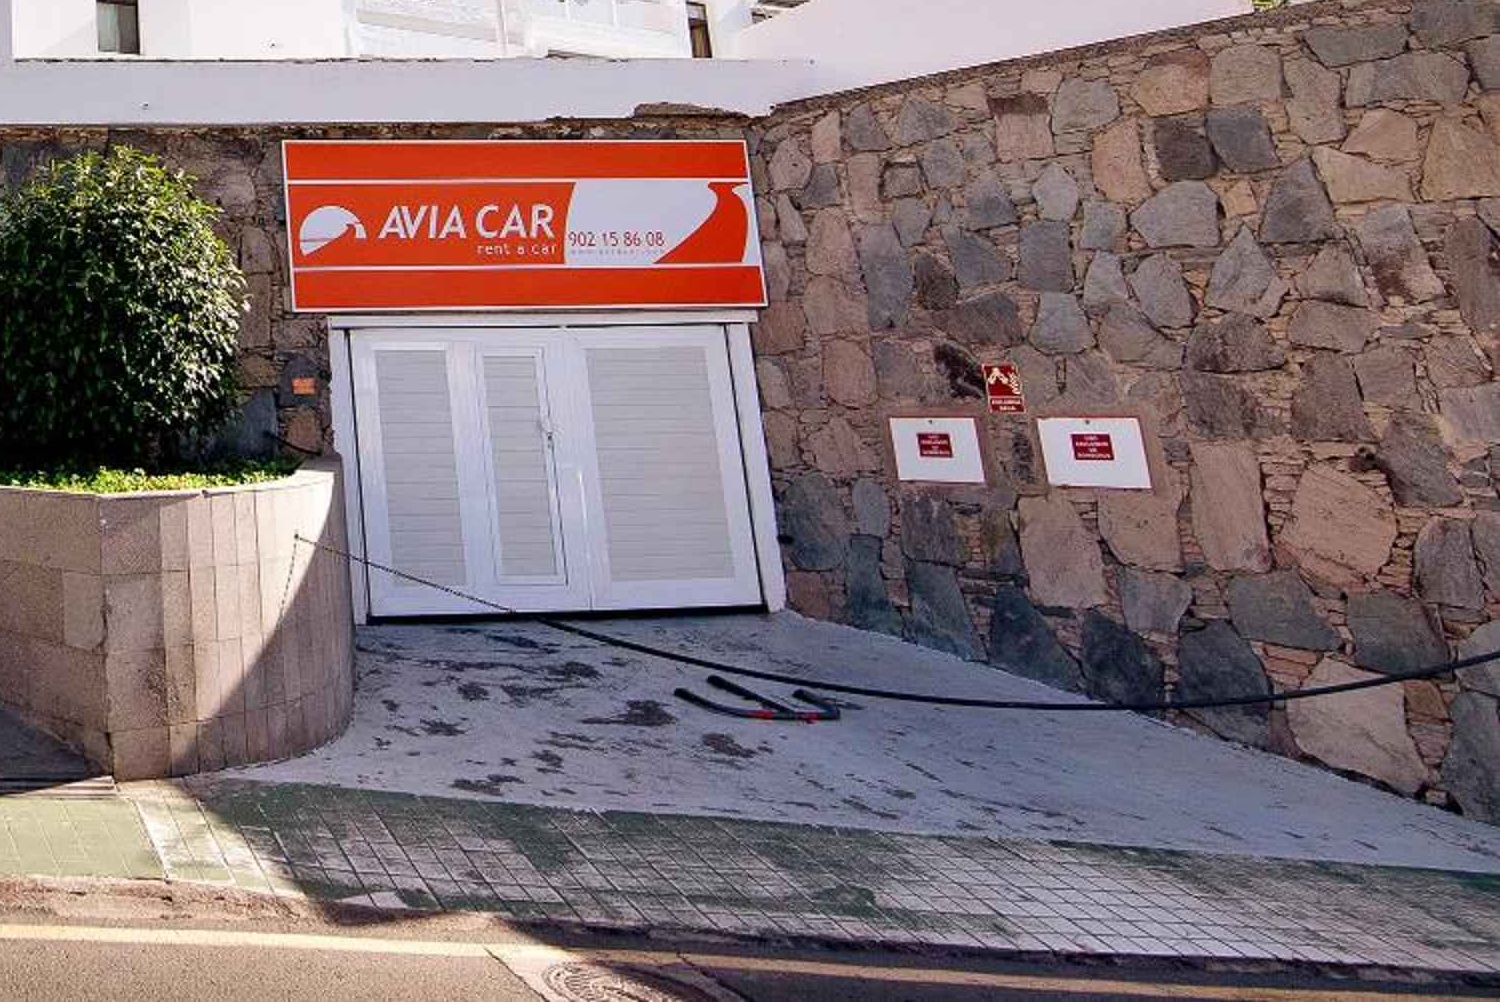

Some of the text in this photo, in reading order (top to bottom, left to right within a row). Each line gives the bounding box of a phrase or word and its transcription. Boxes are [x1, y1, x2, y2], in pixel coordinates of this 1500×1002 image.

[378, 203, 556, 239] AVIA CAR
[569, 231, 665, 247] 902 15 86 08
[477, 243, 557, 255] rent a car
